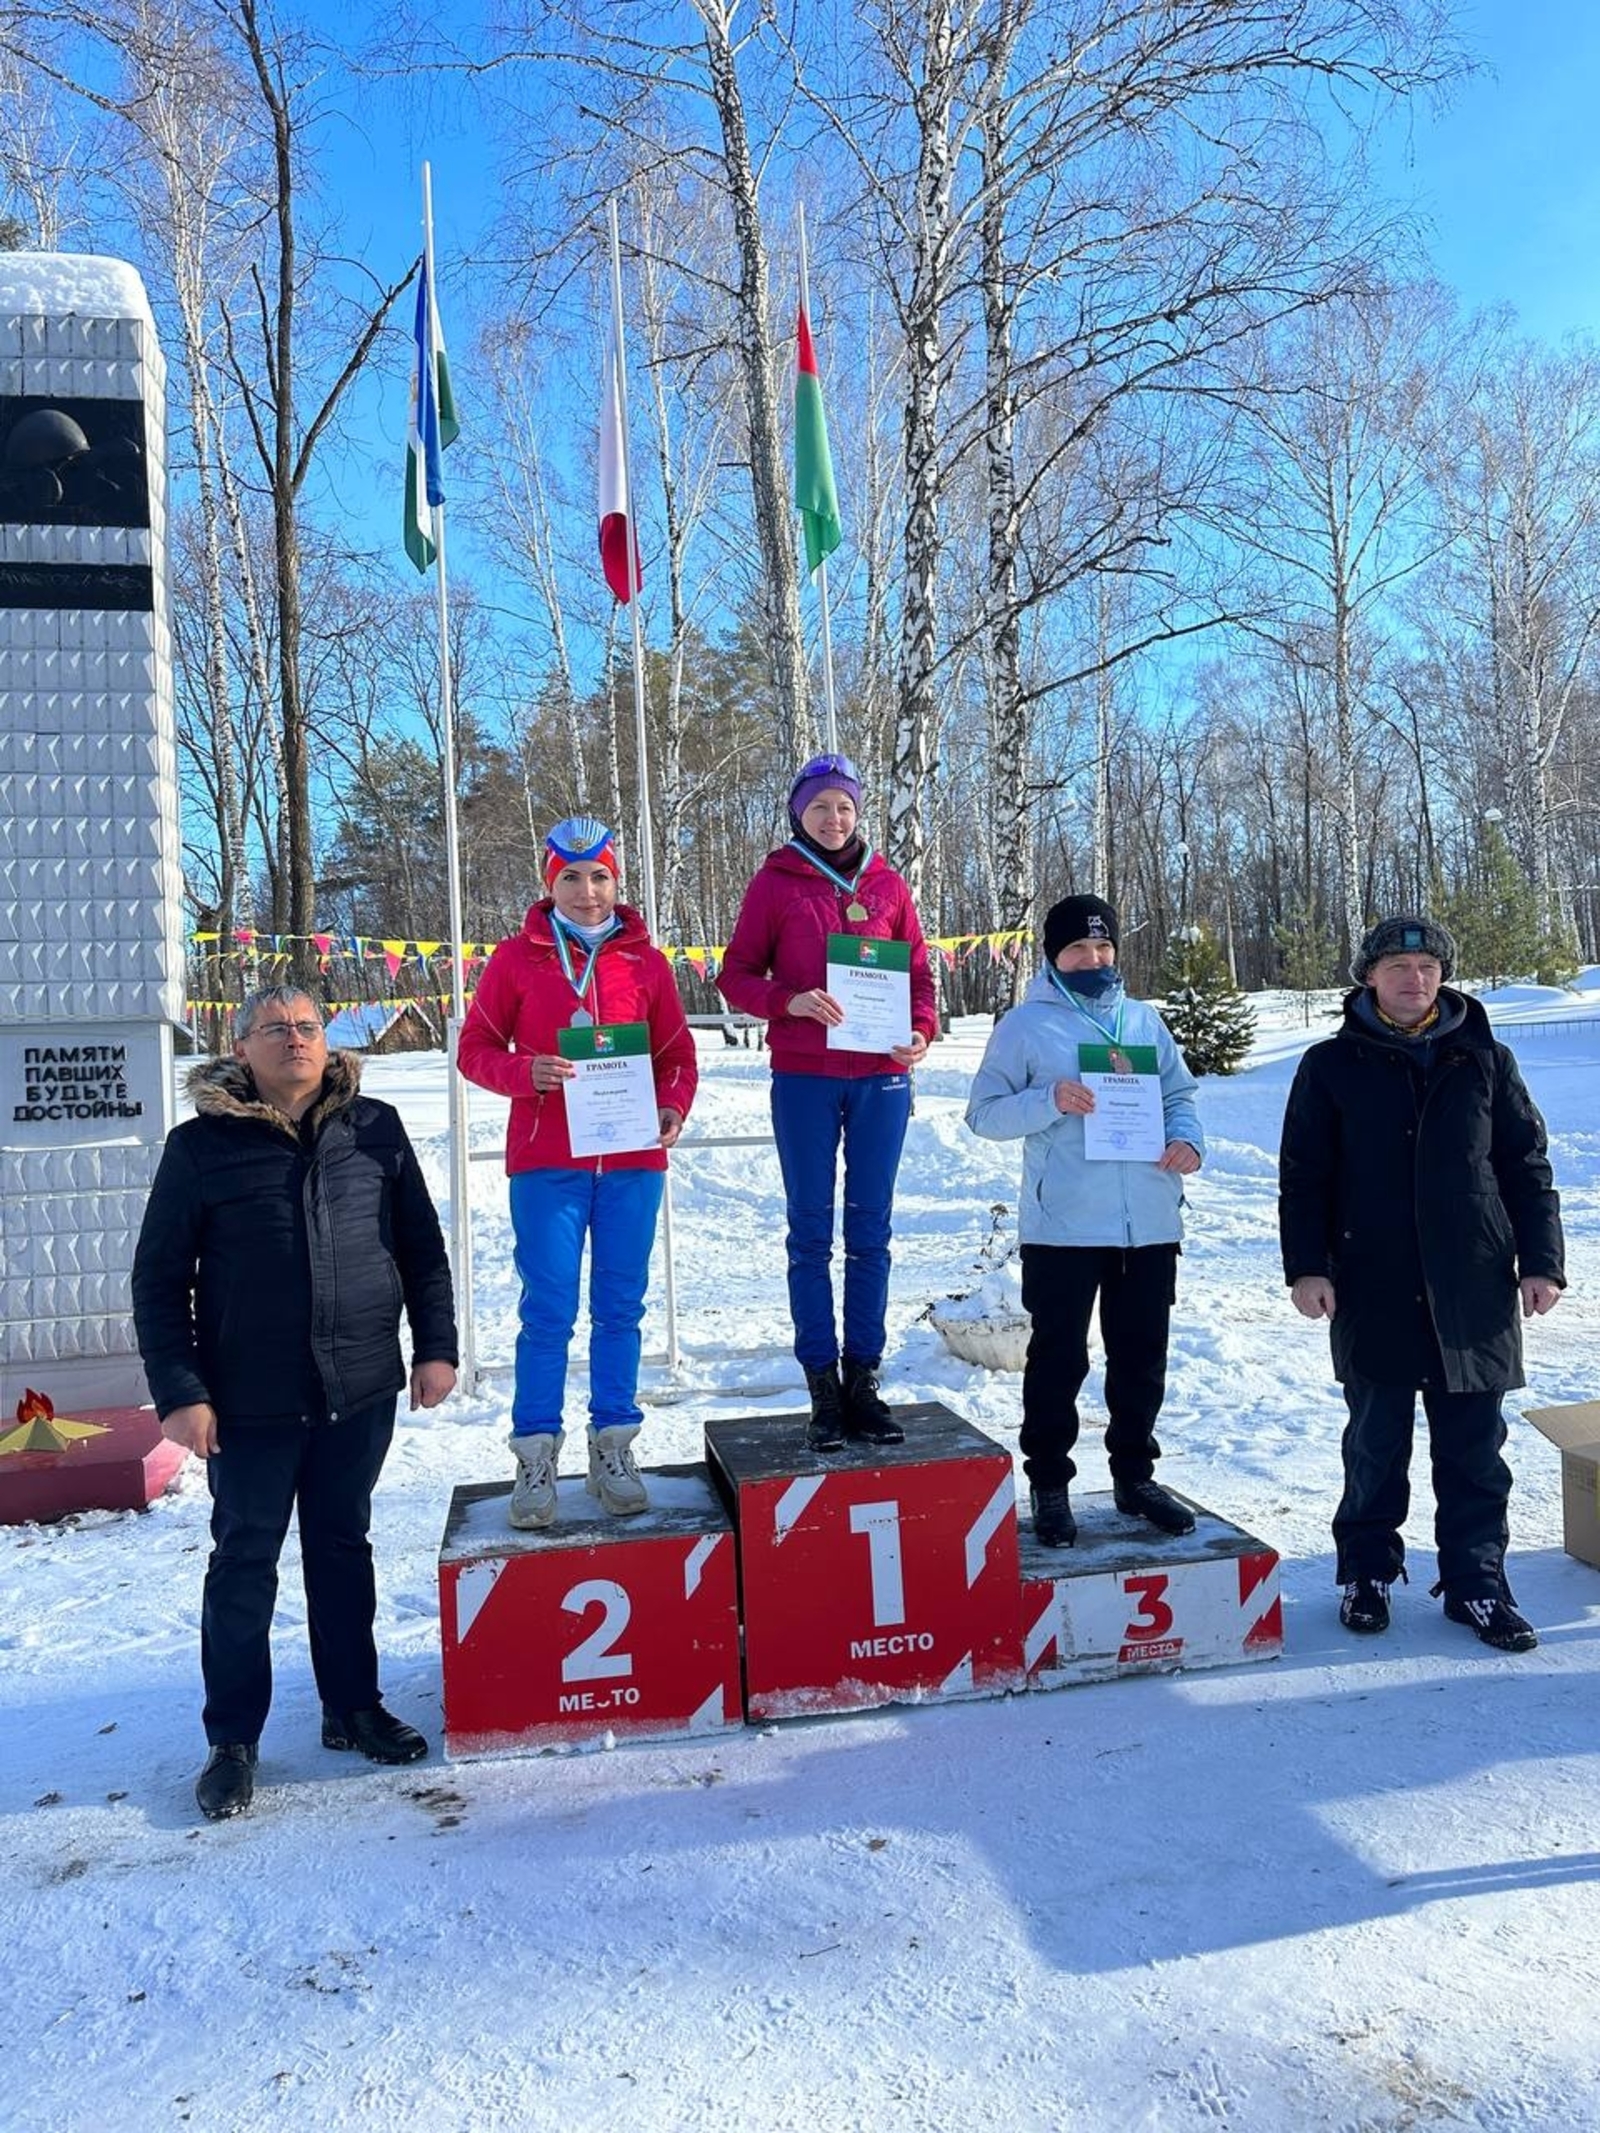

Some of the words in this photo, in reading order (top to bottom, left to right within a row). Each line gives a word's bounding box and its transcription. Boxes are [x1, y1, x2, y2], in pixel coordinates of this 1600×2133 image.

[849, 969, 889, 981] ГРАМОТА
[24, 1046, 126, 1063] ПАМЯТИ
[25, 1065, 125, 1083] ПАВШИХ
[586, 1060, 628, 1072] ГРАМОТА
[1103, 1076, 1140, 1085] ГРАМОТА
[26, 1083, 128, 1101] БУДЬТЕ
[13, 1101, 143, 1122] ДОСТОЙНЫ
[850, 1500, 905, 1627] 1
[1124, 1574, 1173, 1641] 3
[560, 1579, 632, 1683] 2
[851, 1632, 934, 1659] МЕСТО
[1126, 1642, 1175, 1660] МЕСТО
